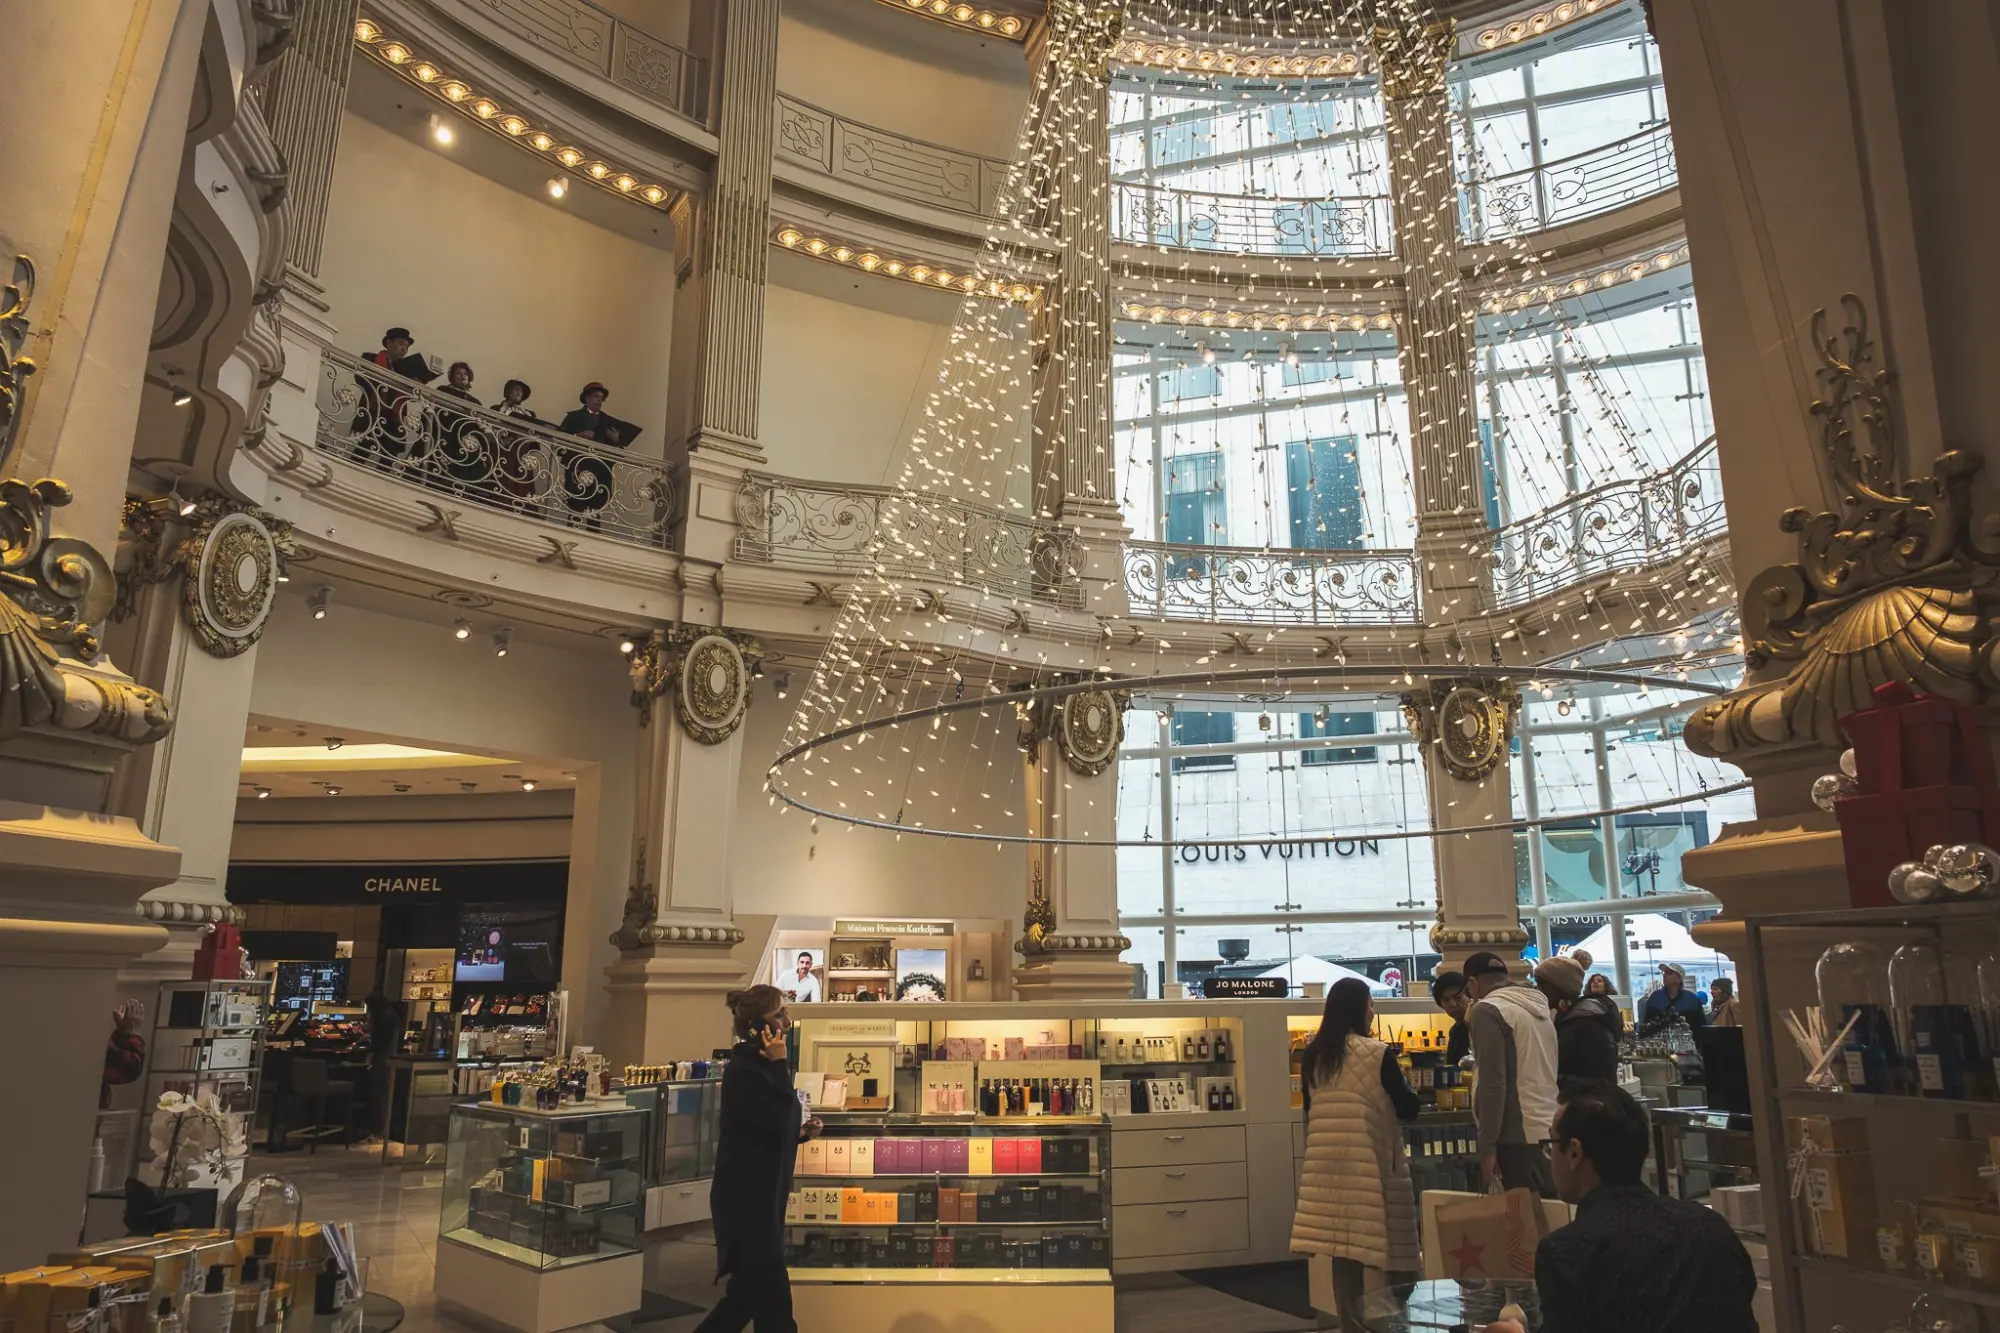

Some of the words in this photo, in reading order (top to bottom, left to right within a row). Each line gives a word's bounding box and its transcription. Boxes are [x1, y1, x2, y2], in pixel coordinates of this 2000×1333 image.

[1174, 843, 1247, 864] OUIS
[1259, 839, 1380, 860] VUITTON
[364, 877, 442, 893] CHANEL
[846, 923, 875, 933] Maison
[876, 923, 906, 934] Francis
[906, 924, 945, 936] Kurkdjian
[1215, 980, 1229, 988] JO
[1231, 979, 1275, 988] MALONE
